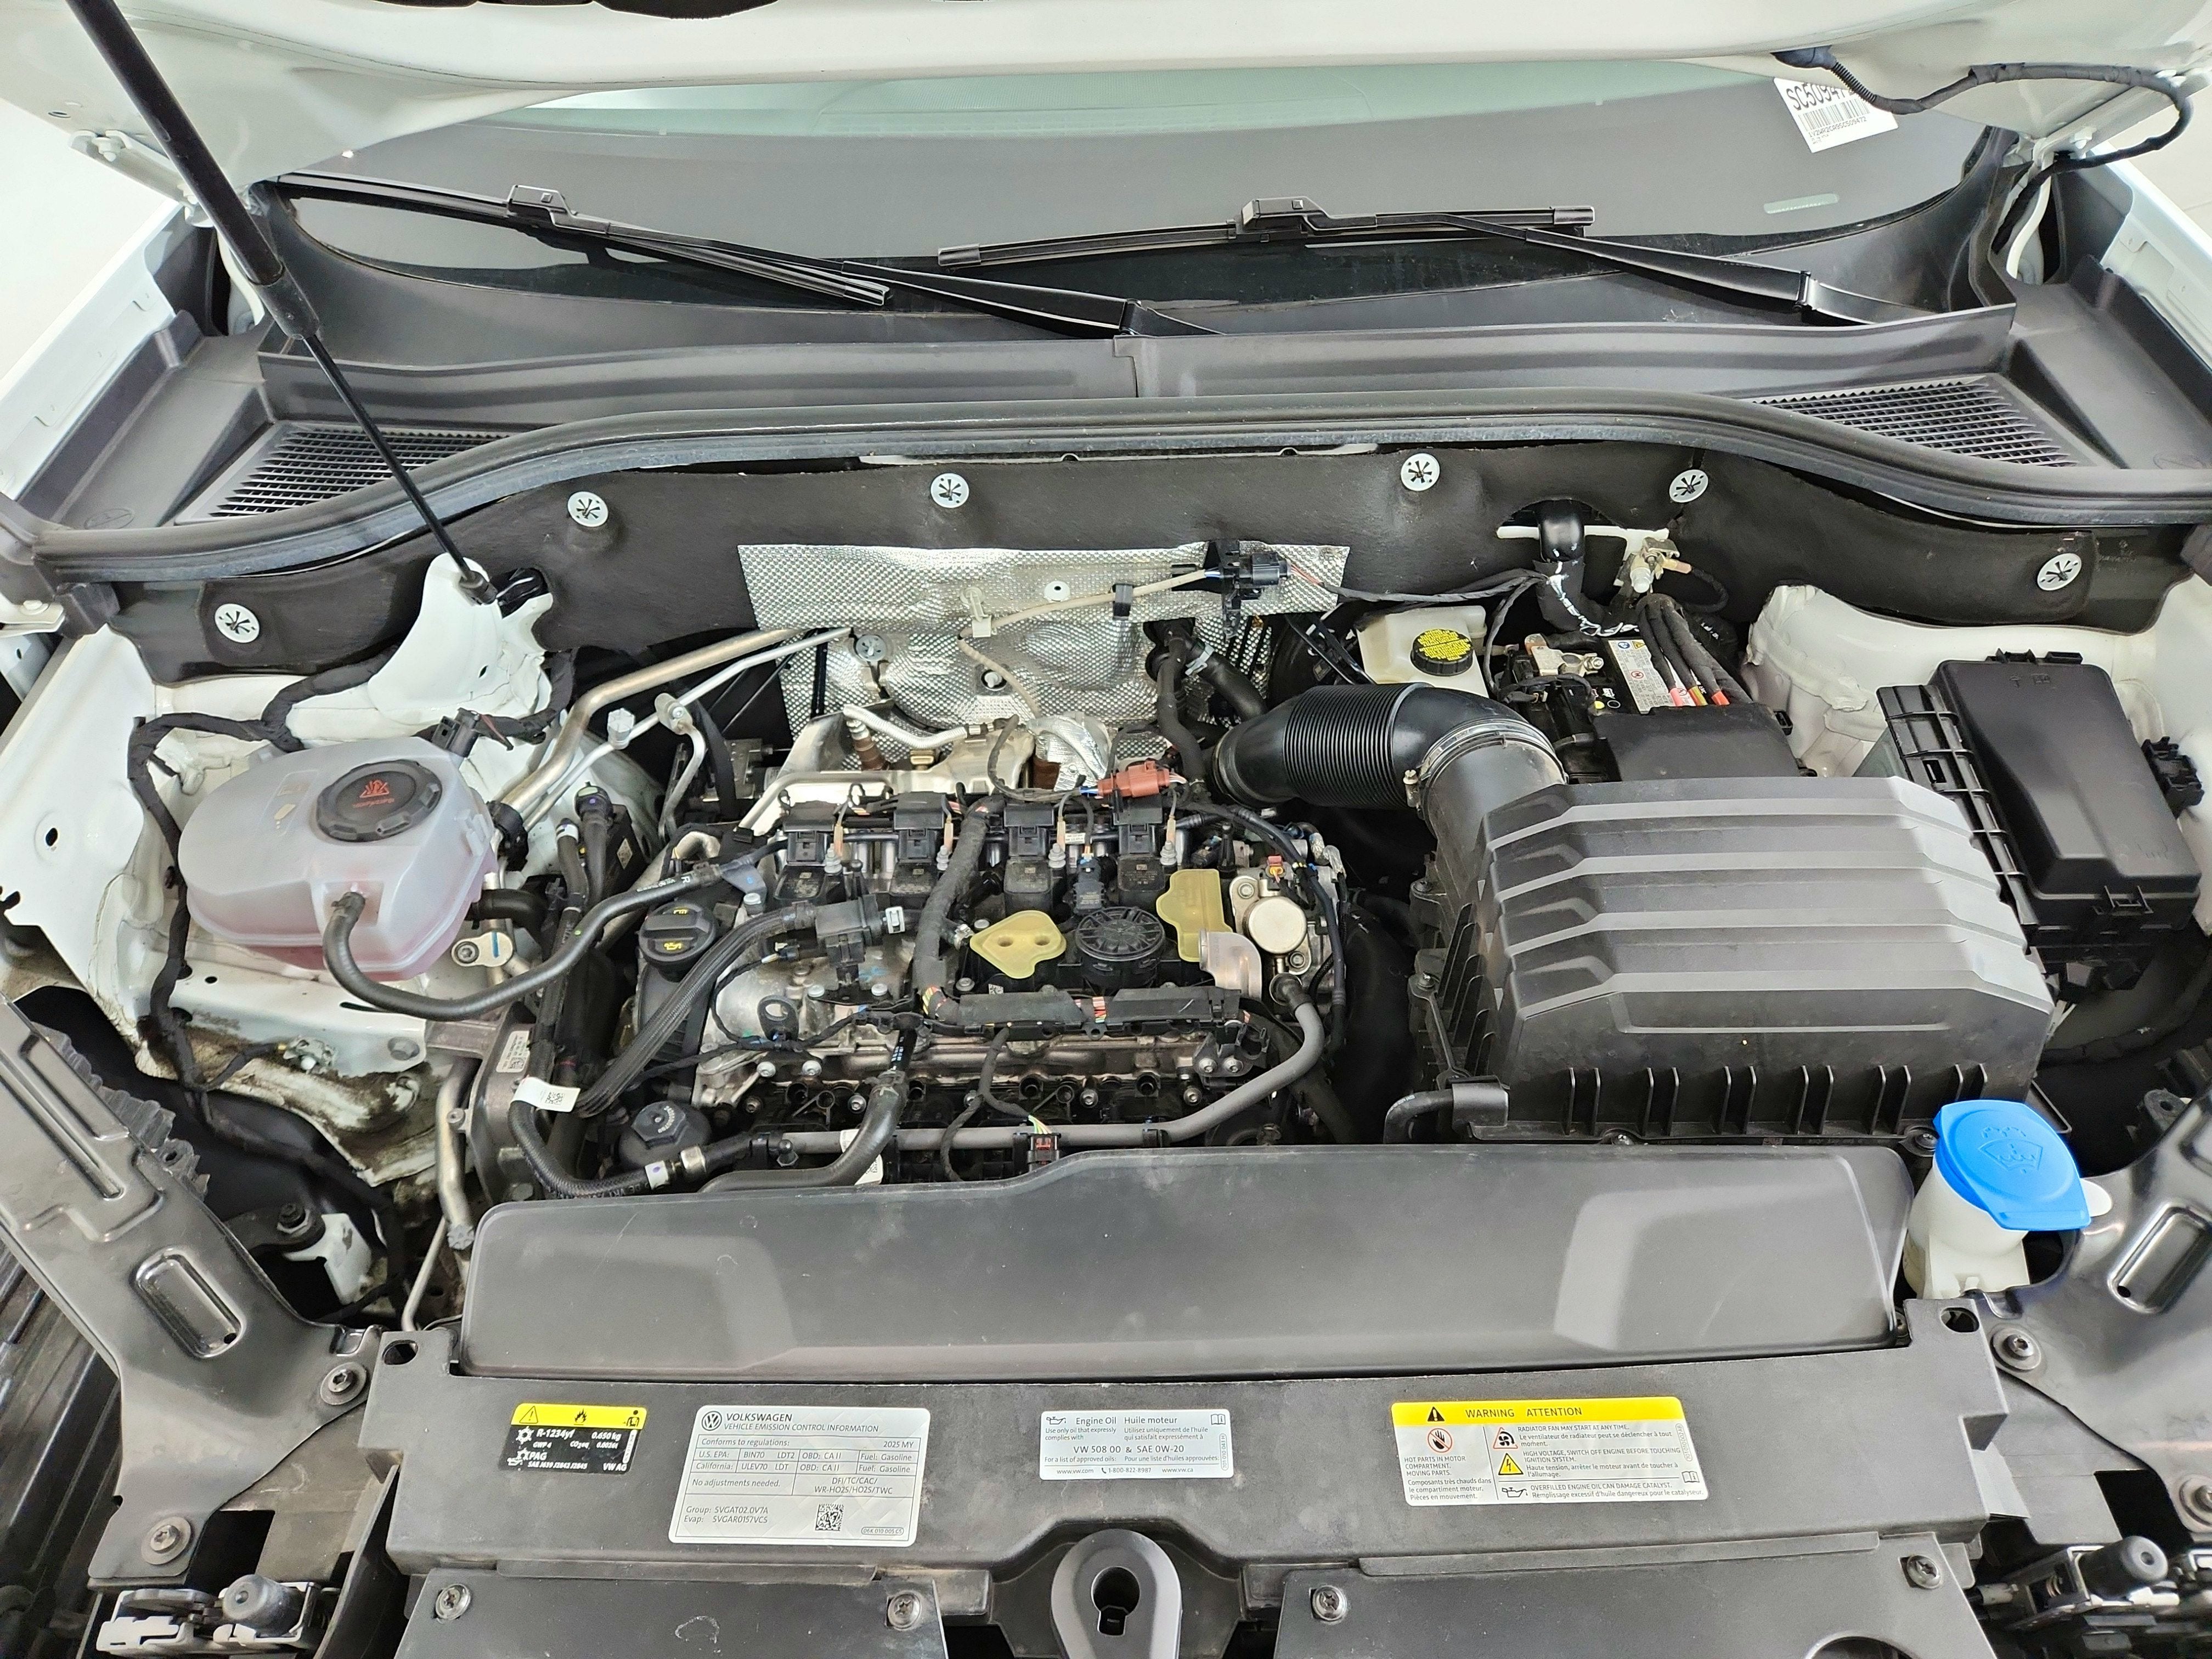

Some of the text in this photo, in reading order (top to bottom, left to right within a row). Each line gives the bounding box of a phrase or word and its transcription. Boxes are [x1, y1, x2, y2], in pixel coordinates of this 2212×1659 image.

[1465, 1407, 1582, 1418] WARNING ATTENTION
[726, 1413, 792, 1421] VOLKSWAGEN
[1076, 1417, 1103, 1426] Engine
[612, 1432, 622, 1441] kg
[747, 1439, 789, 1447] regulations:
[529, 1452, 548, 1460] PAG
[704, 1480, 749, 1488] adjustments
[814, 1486, 893, 1494] WR-HO2S/HO2S/TWC
[686, 1506, 712, 1515] Group:
[684, 1516, 703, 1524] Evap:
